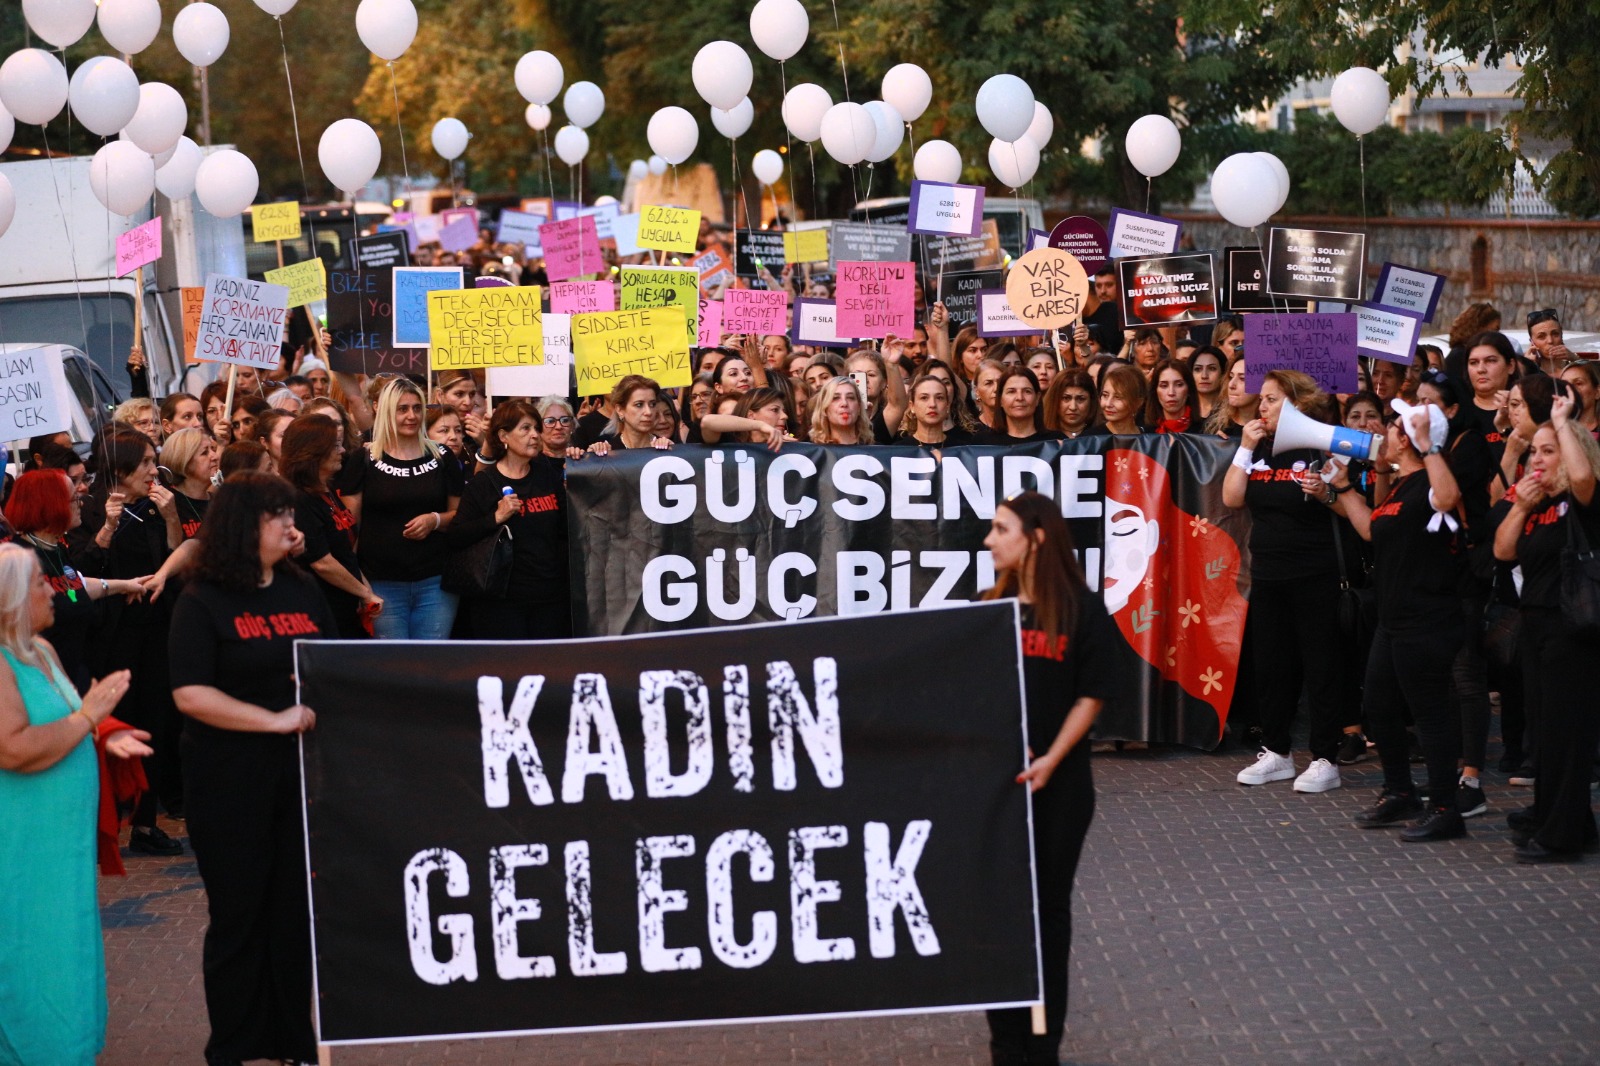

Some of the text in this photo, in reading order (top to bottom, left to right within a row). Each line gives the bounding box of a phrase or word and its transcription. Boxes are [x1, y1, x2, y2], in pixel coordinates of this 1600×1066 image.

[936, 211, 961, 219] UYGULA
[1126, 224, 1166, 237] SUSMUYORUZ
[1122, 234, 1166, 247] KORKMUYORUZ
[1317, 248, 1346, 256] SOLDA
[844, 267, 904, 283] KORKUYU
[1023, 259, 1070, 277] VAR
[331, 272, 377, 294] BİZE
[680, 272, 698, 289] BİR
[958, 279, 982, 290] KADIN
[1141, 272, 1194, 285] HAYATIMIZ
[1292, 274, 1336, 283] KOLTUKTA
[214, 278, 260, 301] KADINIZ
[555, 282, 596, 297] HEPİMİZ
[860, 283, 891, 295] DEĞİL
[1030, 277, 1072, 298] BİR
[1128, 283, 1209, 297] BU KADAR UCUZ
[433, 296, 471, 310] TEK
[479, 293, 534, 308] ADAM
[577, 297, 597, 307] İÇİN
[636, 288, 676, 306] HESAP
[728, 291, 787, 305] TOPLUMSAL
[844, 298, 889, 310] SEVGİYİ
[1142, 295, 1196, 307] OLMAMALI
[212, 297, 284, 324] KORKMAYIZ
[735, 306, 779, 317] CİNSİYET
[1023, 293, 1081, 320] ÇARESİ
[1288, 318, 1334, 330] KADINA
[1359, 313, 1380, 324] SUSMA
[200, 315, 278, 342] HER ZAMAN
[1365, 325, 1395, 337] YAŞAMAK
[335, 330, 382, 352] SİZE
[1257, 333, 1350, 346] TEKME ATMAK
[376, 350, 423, 369] YOK
[437, 345, 541, 366] DÜZELECEK
[1274, 348, 1331, 360] YALNIZCA
[374, 458, 438, 477] MORE LIKE
[640, 450, 1104, 529] GÜÇ SENDE
[642, 548, 818, 622] GÜÇ
[234, 612, 272, 640] GÜÇ
[476, 656, 844, 808] KADIN
[404, 819, 941, 985] GELECEK
